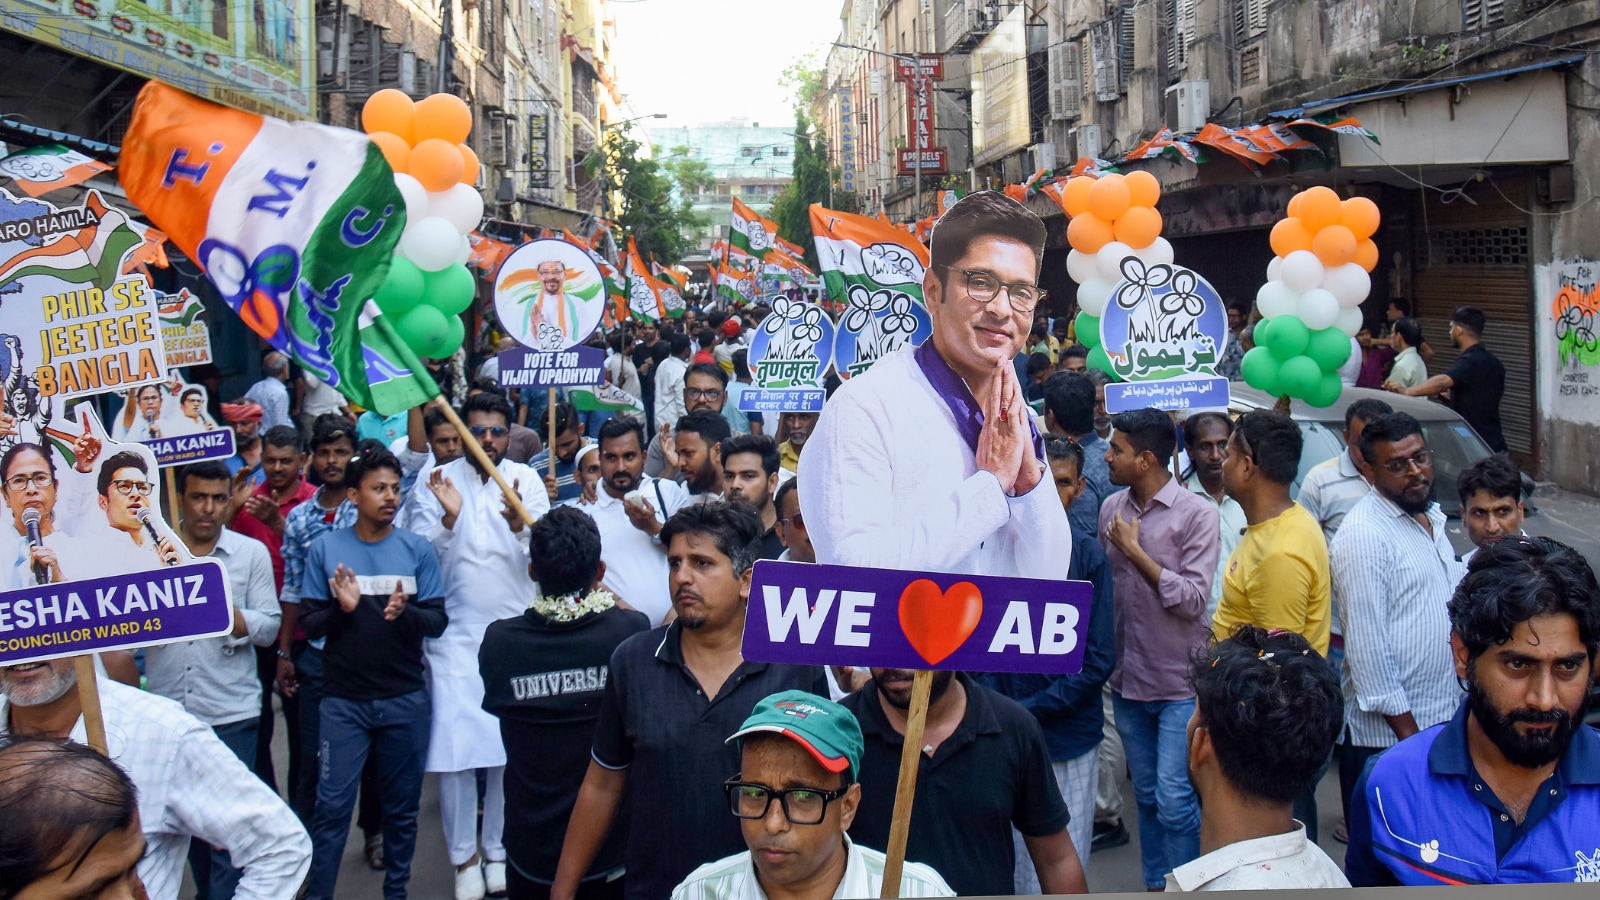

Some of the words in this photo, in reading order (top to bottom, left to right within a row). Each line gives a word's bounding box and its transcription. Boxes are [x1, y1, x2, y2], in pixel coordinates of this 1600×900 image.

[841, 95, 854, 191] AMBASSADOR
[902, 151, 940, 161] APPRELS
[36, 209, 98, 234] HAMLA
[42, 286, 107, 323] PHIR
[111, 280, 147, 310] SE
[39, 312, 156, 365] JEETEGE
[160, 325, 187, 337] PHIR
[189, 323, 205, 334] SE
[163, 335, 208, 352] EETEGE
[165, 349, 209, 365] ANGLA
[523, 352, 554, 369] VOTE
[555, 352, 580, 368] FOR
[1114, 338, 1216, 376] ترنمول
[37, 348, 161, 397] BANGLA
[501, 369, 537, 386] VIJAY
[538, 367, 601, 385] UPADHYAY
[757, 360, 819, 388] तृणमूल
[743, 391, 757, 402] इस
[760, 390, 786, 401] निशान
[789, 392, 801, 401] पर
[755, 401, 780, 410] दबाकर
[784, 400, 799, 410] वोट
[147, 441, 174, 455] HA
[176, 434, 226, 452] KANIZ
[175, 451, 195, 460] WARD
[361, 580, 393, 590] TYLE
[0, 592, 90, 632] ESHA
[96, 574, 207, 618] KANIZ
[761, 585, 877, 648] WE
[987, 600, 1080, 656] AB
[0, 629, 91, 653] COUNCILLOR
[93, 620, 140, 639] WARD
[143, 617, 162, 632] 43
